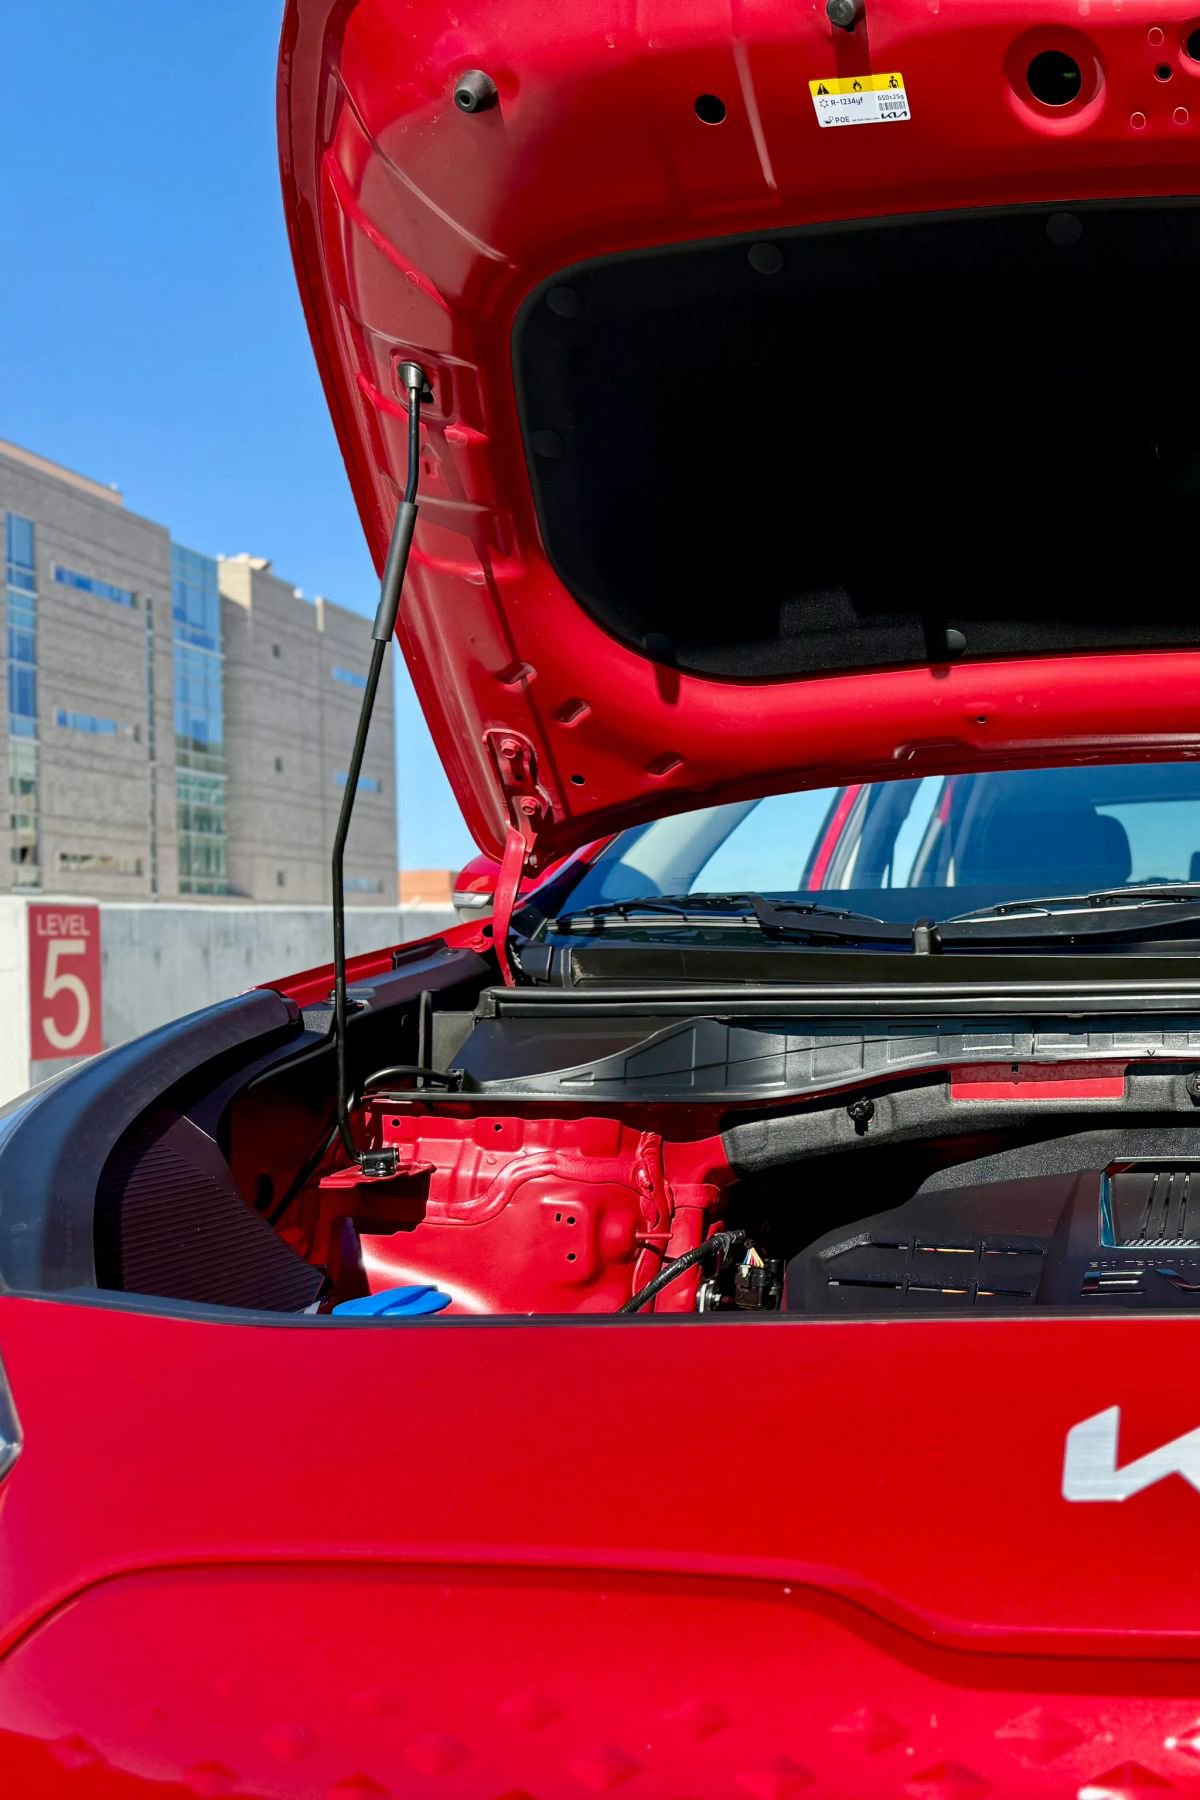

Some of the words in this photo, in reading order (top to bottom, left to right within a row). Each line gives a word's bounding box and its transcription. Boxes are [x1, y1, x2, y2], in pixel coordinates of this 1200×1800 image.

[830, 97, 864, 107] R-1234yf
[835, 116, 850, 124] POE
[881, 110, 908, 120] KIA
[37, 913, 90, 936] LEVEL
[42, 939, 90, 1050] 5
